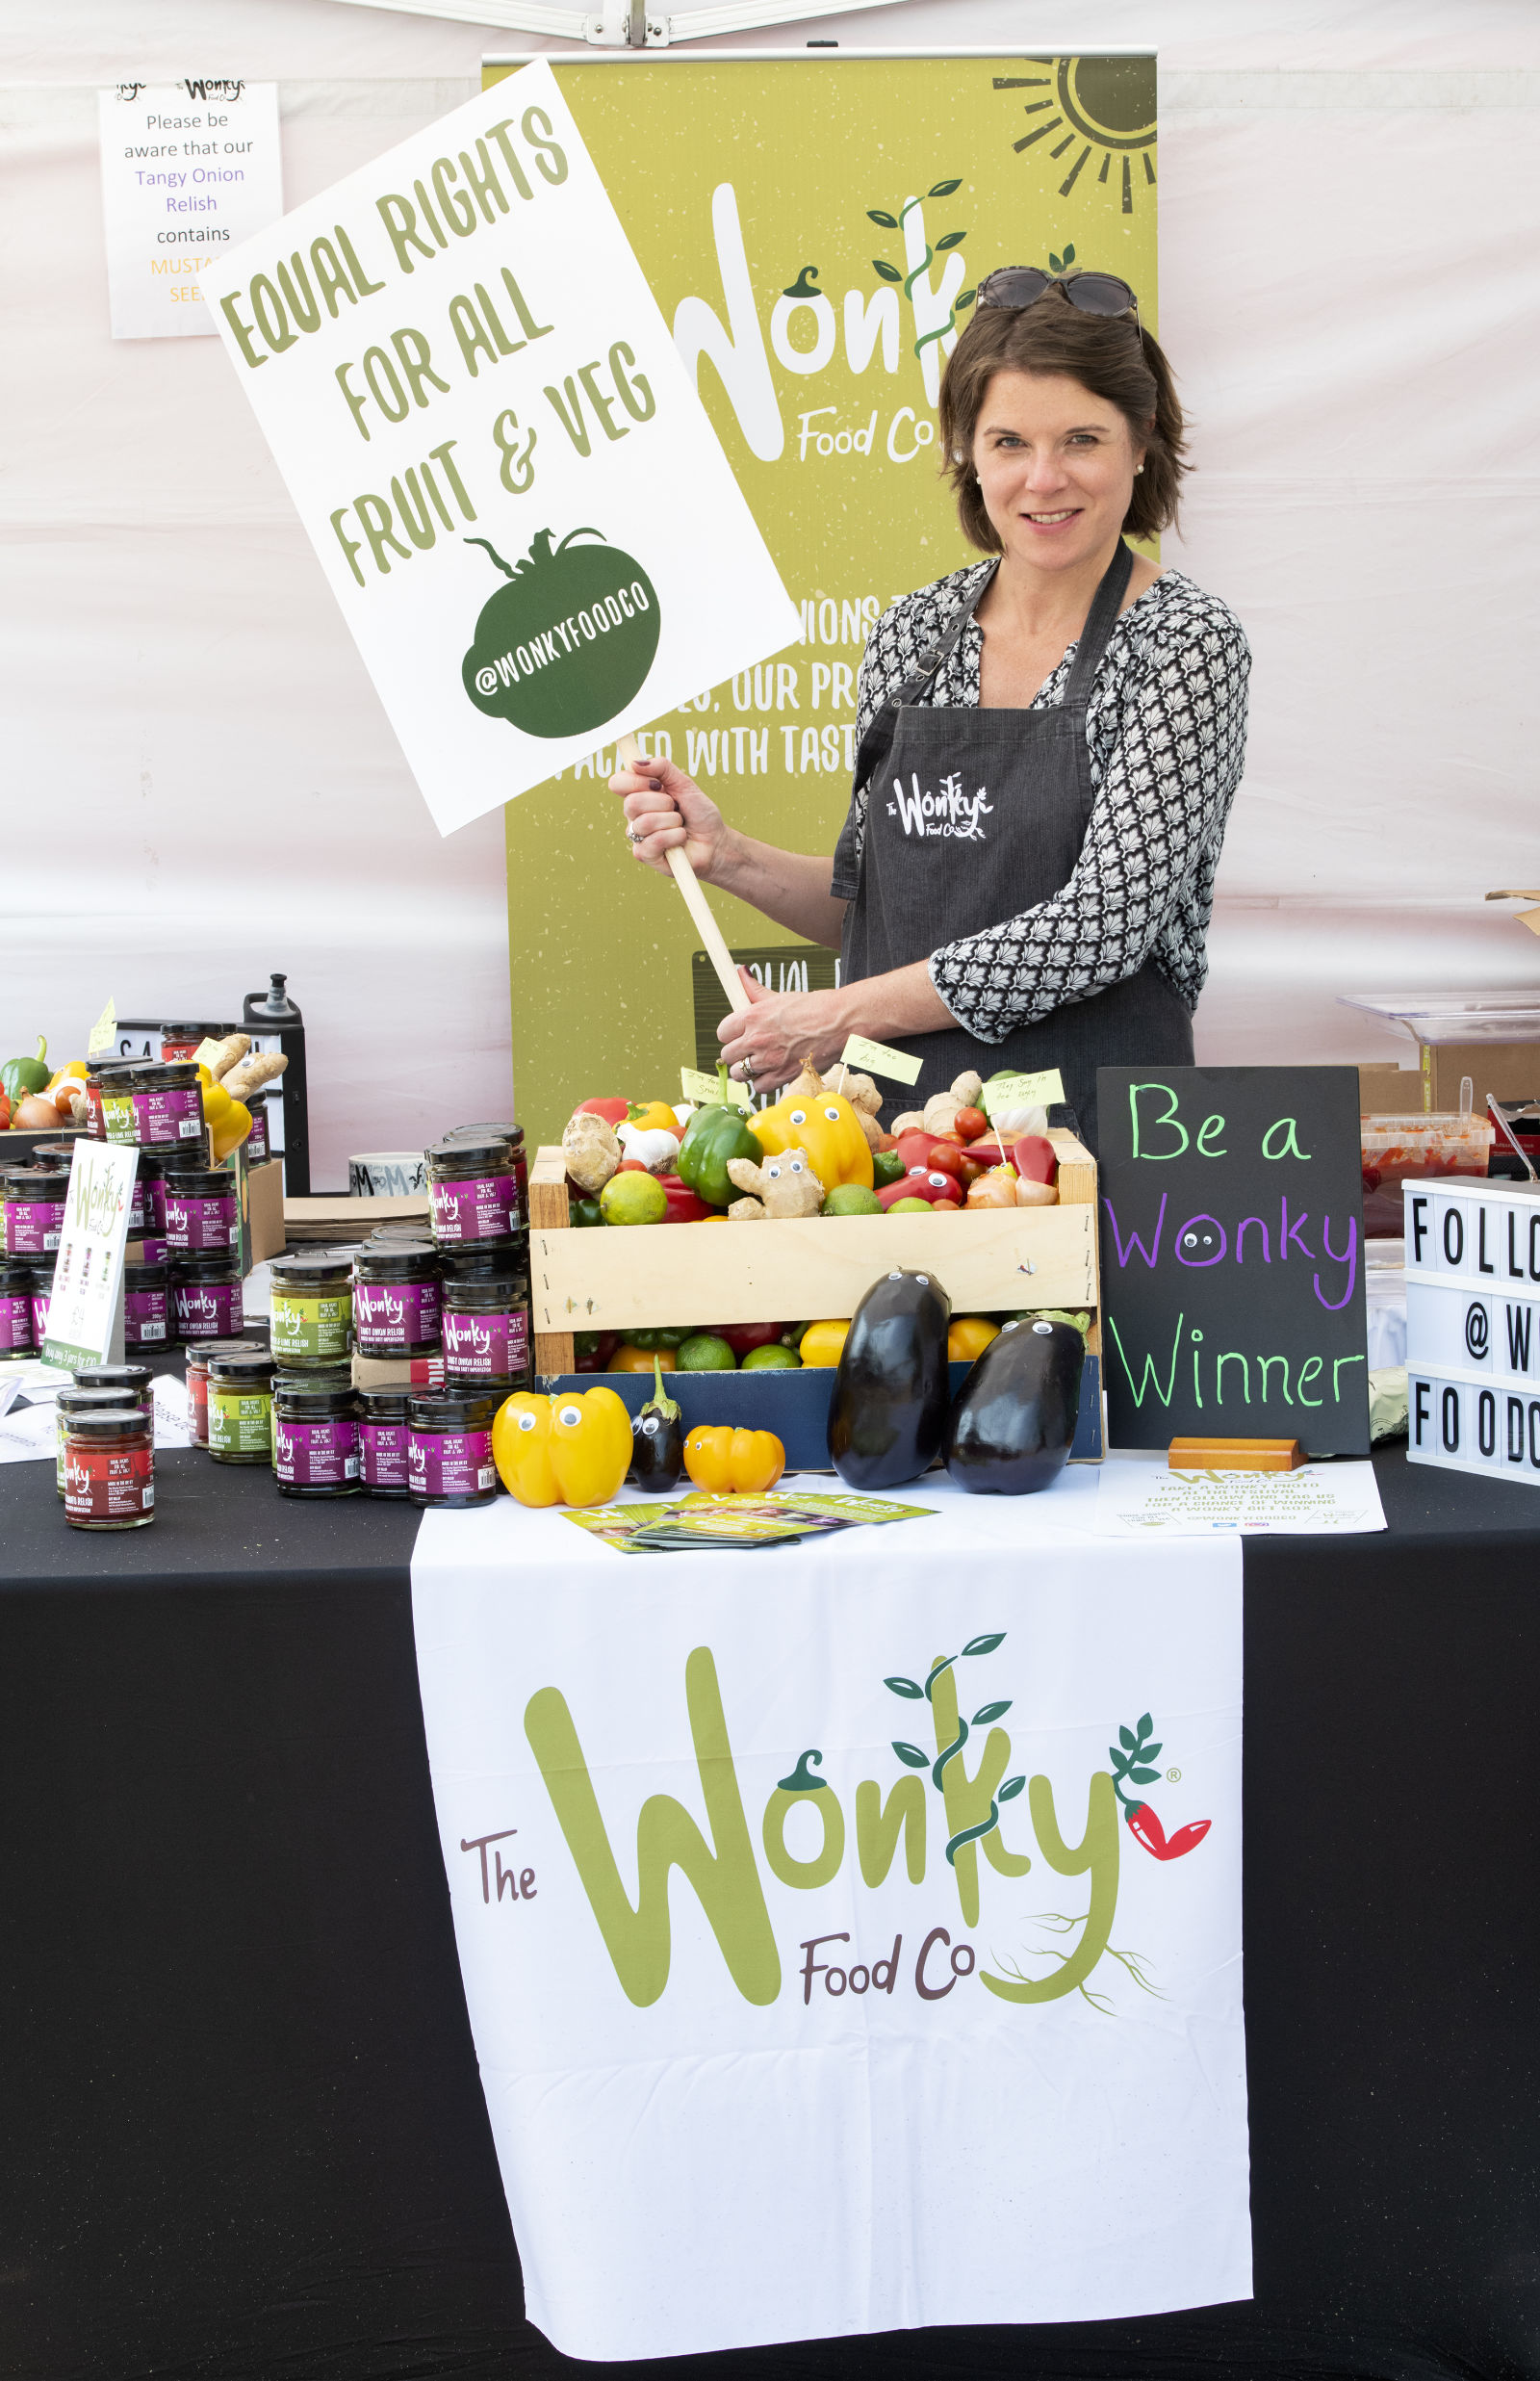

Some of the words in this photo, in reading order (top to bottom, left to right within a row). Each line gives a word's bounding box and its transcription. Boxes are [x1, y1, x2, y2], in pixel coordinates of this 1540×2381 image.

[146, 114, 201, 129] Please
[207, 113, 228, 127] be
[124, 144, 177, 158] aware
[184, 141, 218, 156] that
[223, 142, 253, 154] our
[136, 169, 187, 188] Tangy
[192, 168, 244, 183] Onion
[167, 195, 217, 213] Relish
[157, 226, 230, 244] contains
[219, 223, 386, 369] EQUAL
[375, 105, 569, 274] RIGHTS
[151, 256, 220, 275] MUSTA
[170, 286, 205, 302] SEE
[674, 182, 965, 462] Wonk
[334, 326, 450, 442] FOR
[449, 267, 554, 377] ALL
[797, 405, 878, 462] Food
[886, 406, 934, 463] Co
[329, 439, 477, 587] FRUIT
[492, 409, 537, 495] &
[543, 340, 656, 457] VEG
[474, 581, 651, 697] @WONKYFOODCO
[732, 662, 800, 712] OUR
[811, 661, 861, 710] PR
[686, 727, 768, 777] WITH
[886, 801, 897, 816] The
[893, 772, 980, 838] Wonky
[926, 823, 943, 836] Food
[1130, 1083, 1227, 1160] Be
[1262, 1118, 1312, 1160] a
[76, 1157, 118, 1237] Wonky
[166, 1200, 187, 1230] onky
[1102, 1192, 1357, 1310] Wonky
[175, 1288, 217, 1319] Wonky
[357, 1286, 403, 1324] Wonky
[45, 1344, 54, 1361] buy
[444, 1315, 491, 1354] Wonky
[1109, 1312, 1365, 1409] Winner
[65, 1457, 89, 1494] onky
[1168, 1469, 1307, 1485] Wonky
[460, 1829, 538, 1905] The
[524, 1645, 1121, 2008] Wonky
[799, 1931, 903, 2006] Food
[914, 1927, 976, 2002] Co
